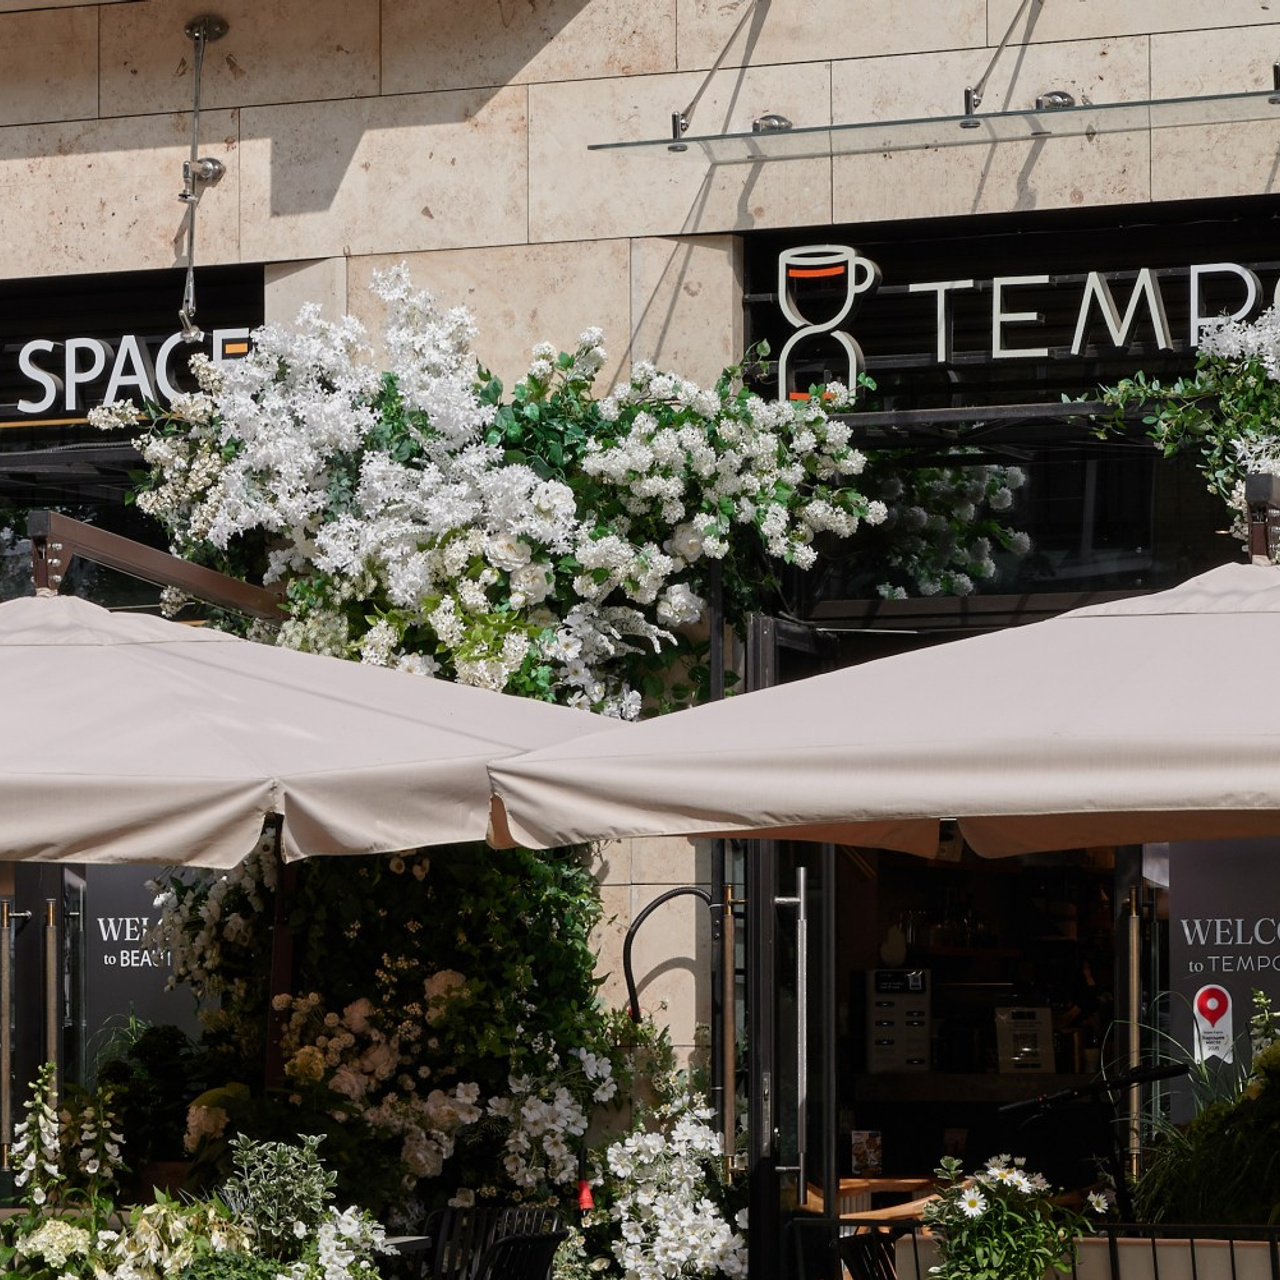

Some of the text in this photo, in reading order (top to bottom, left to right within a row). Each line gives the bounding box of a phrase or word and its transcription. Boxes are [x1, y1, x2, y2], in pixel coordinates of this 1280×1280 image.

[908, 262, 1280, 361] TEMP
[1180, 917, 1280, 946] WELC
[103, 954, 117, 965] to
[1188, 960, 1204, 973] to
